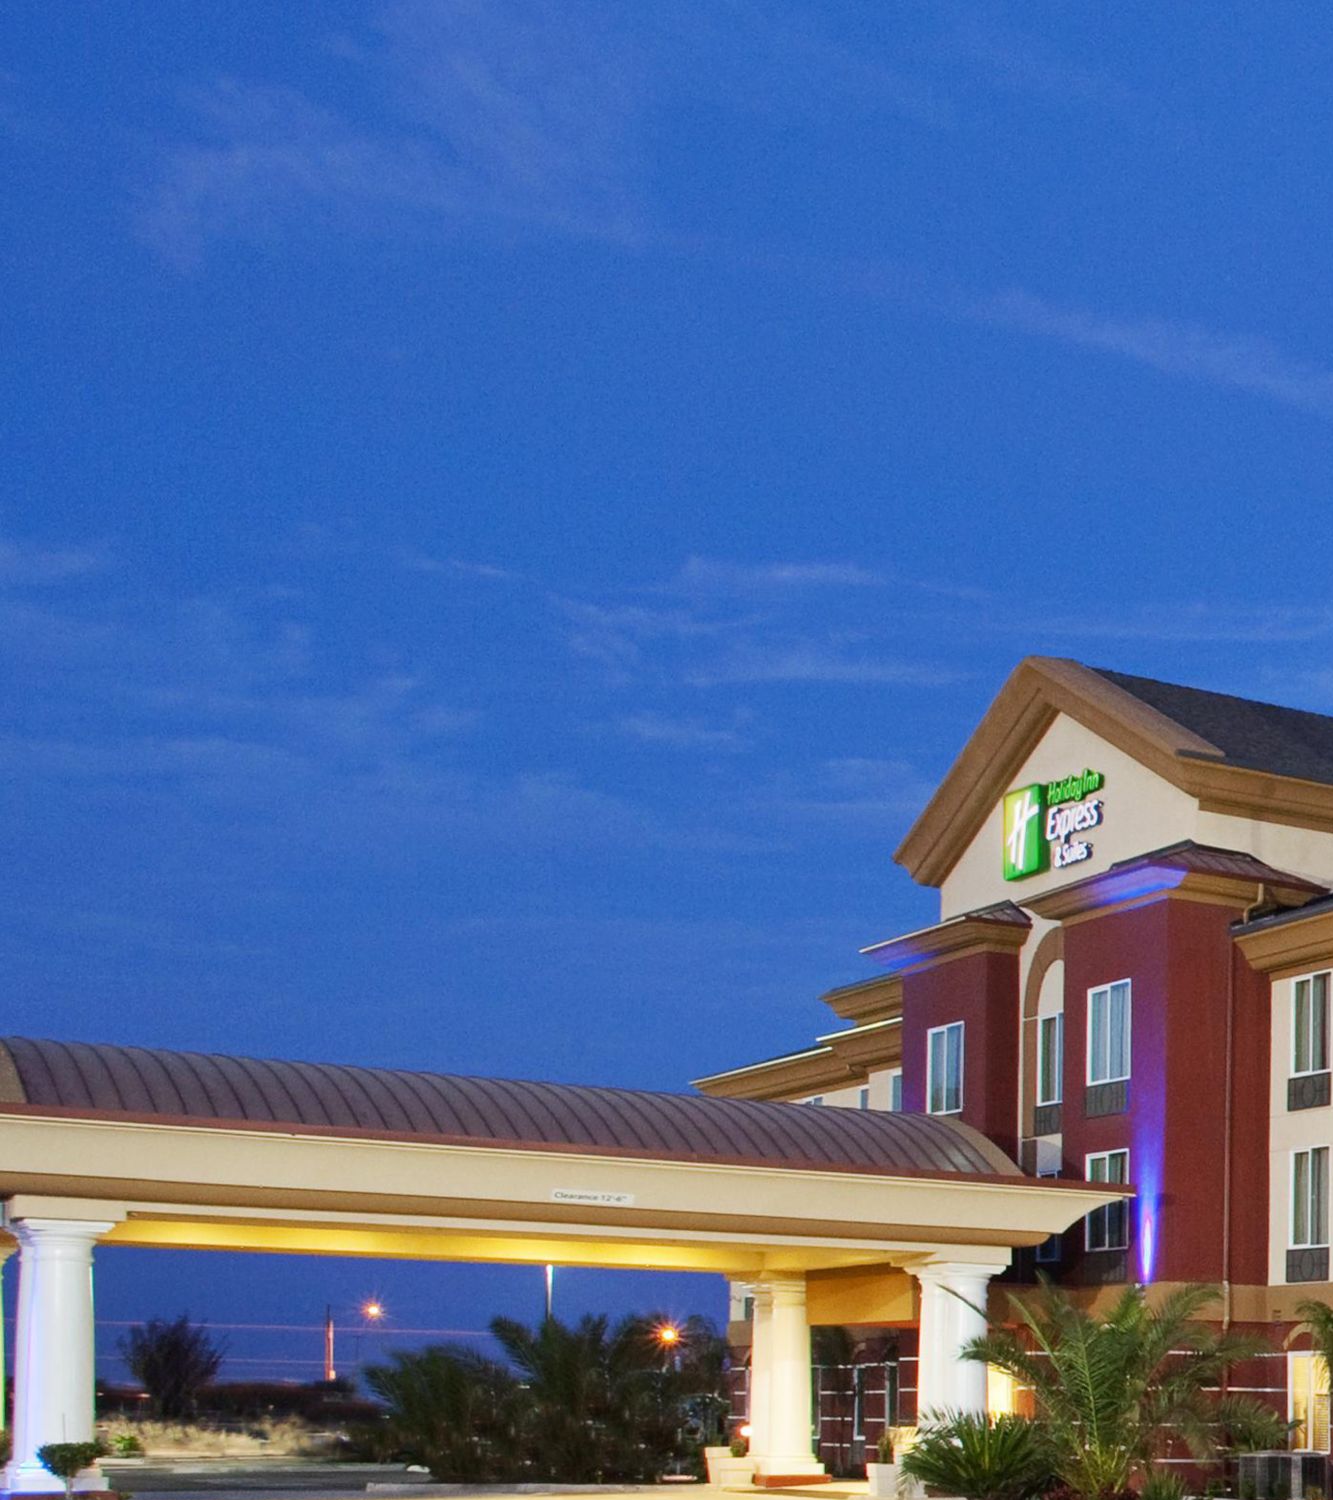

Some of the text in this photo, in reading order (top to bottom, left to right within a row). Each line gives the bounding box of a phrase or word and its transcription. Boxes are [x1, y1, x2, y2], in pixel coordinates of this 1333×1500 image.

[1047, 769, 1100, 806] Holiday Inn
[1045, 799, 1099, 844] Express
[554, 1191, 599, 1201] Clearance
